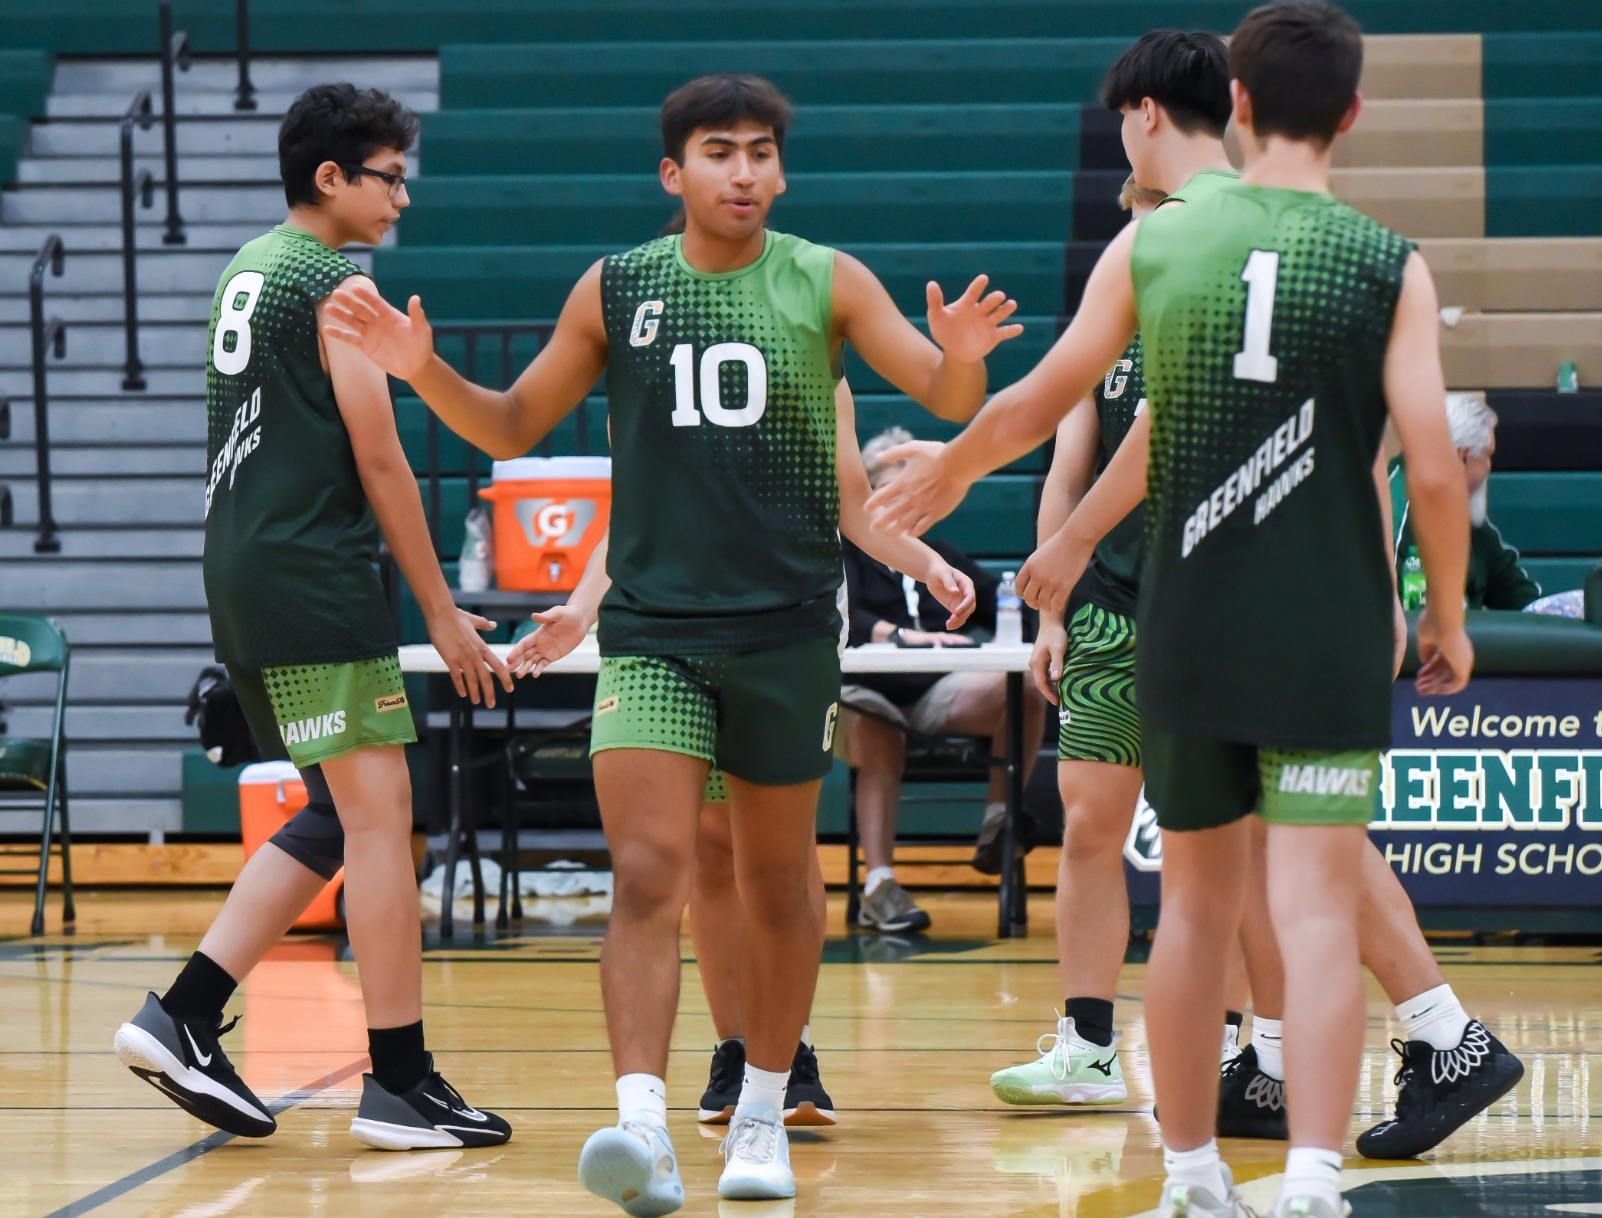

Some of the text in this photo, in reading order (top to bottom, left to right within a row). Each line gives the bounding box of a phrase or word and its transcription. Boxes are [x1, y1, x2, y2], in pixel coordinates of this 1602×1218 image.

[213, 270, 264, 375] 8
[629, 300, 664, 347] G
[1233, 249, 1279, 383] 1
[669, 342, 767, 427] 10
[1104, 359, 1133, 399] G
[1181, 397, 1315, 559] GREENFIELD
[538, 504, 567, 537] G
[1411, 704, 1580, 737] Welcome
[1279, 764, 1373, 797] HAWKS
[1385, 843, 1602, 875] HIGH SCHO
